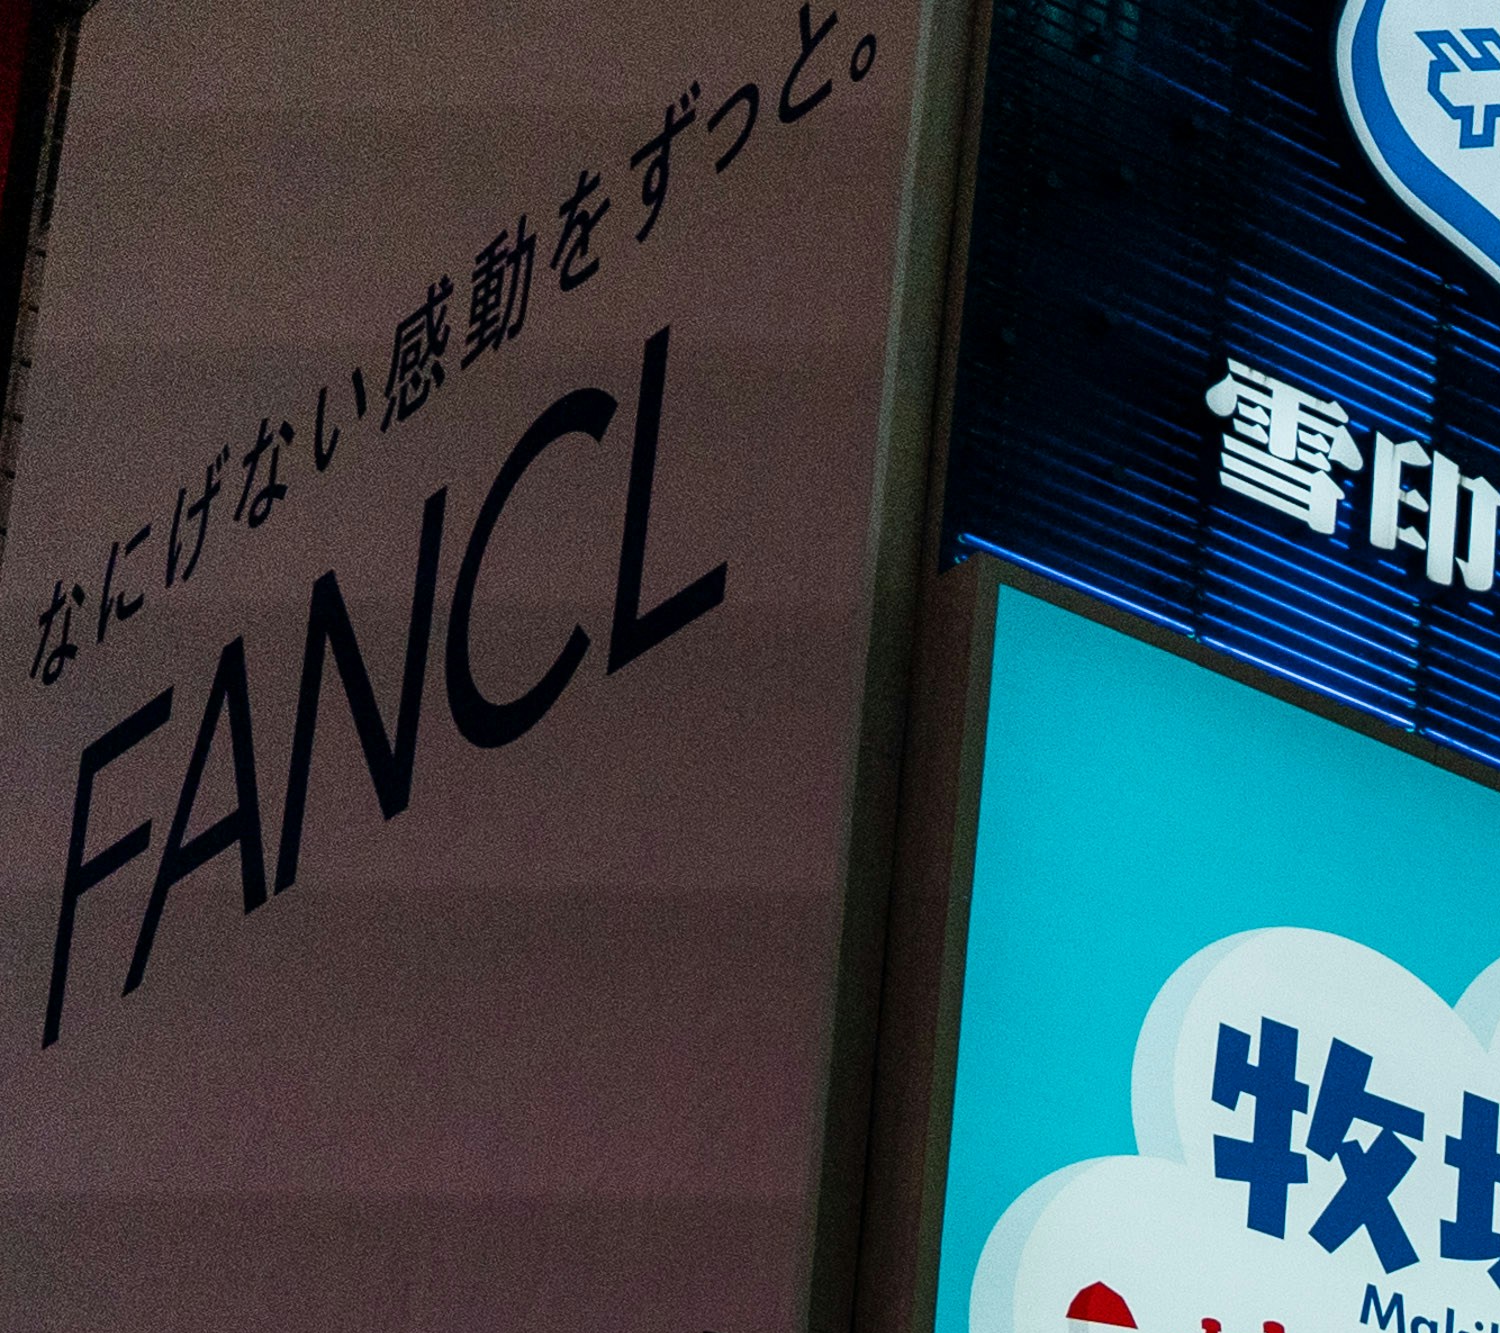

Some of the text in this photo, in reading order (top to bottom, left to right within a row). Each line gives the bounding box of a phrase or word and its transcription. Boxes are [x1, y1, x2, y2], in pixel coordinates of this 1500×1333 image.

[30, 8, 877, 686] なにげない感動をずっと。
[42, 326, 728, 1050] FANCL
